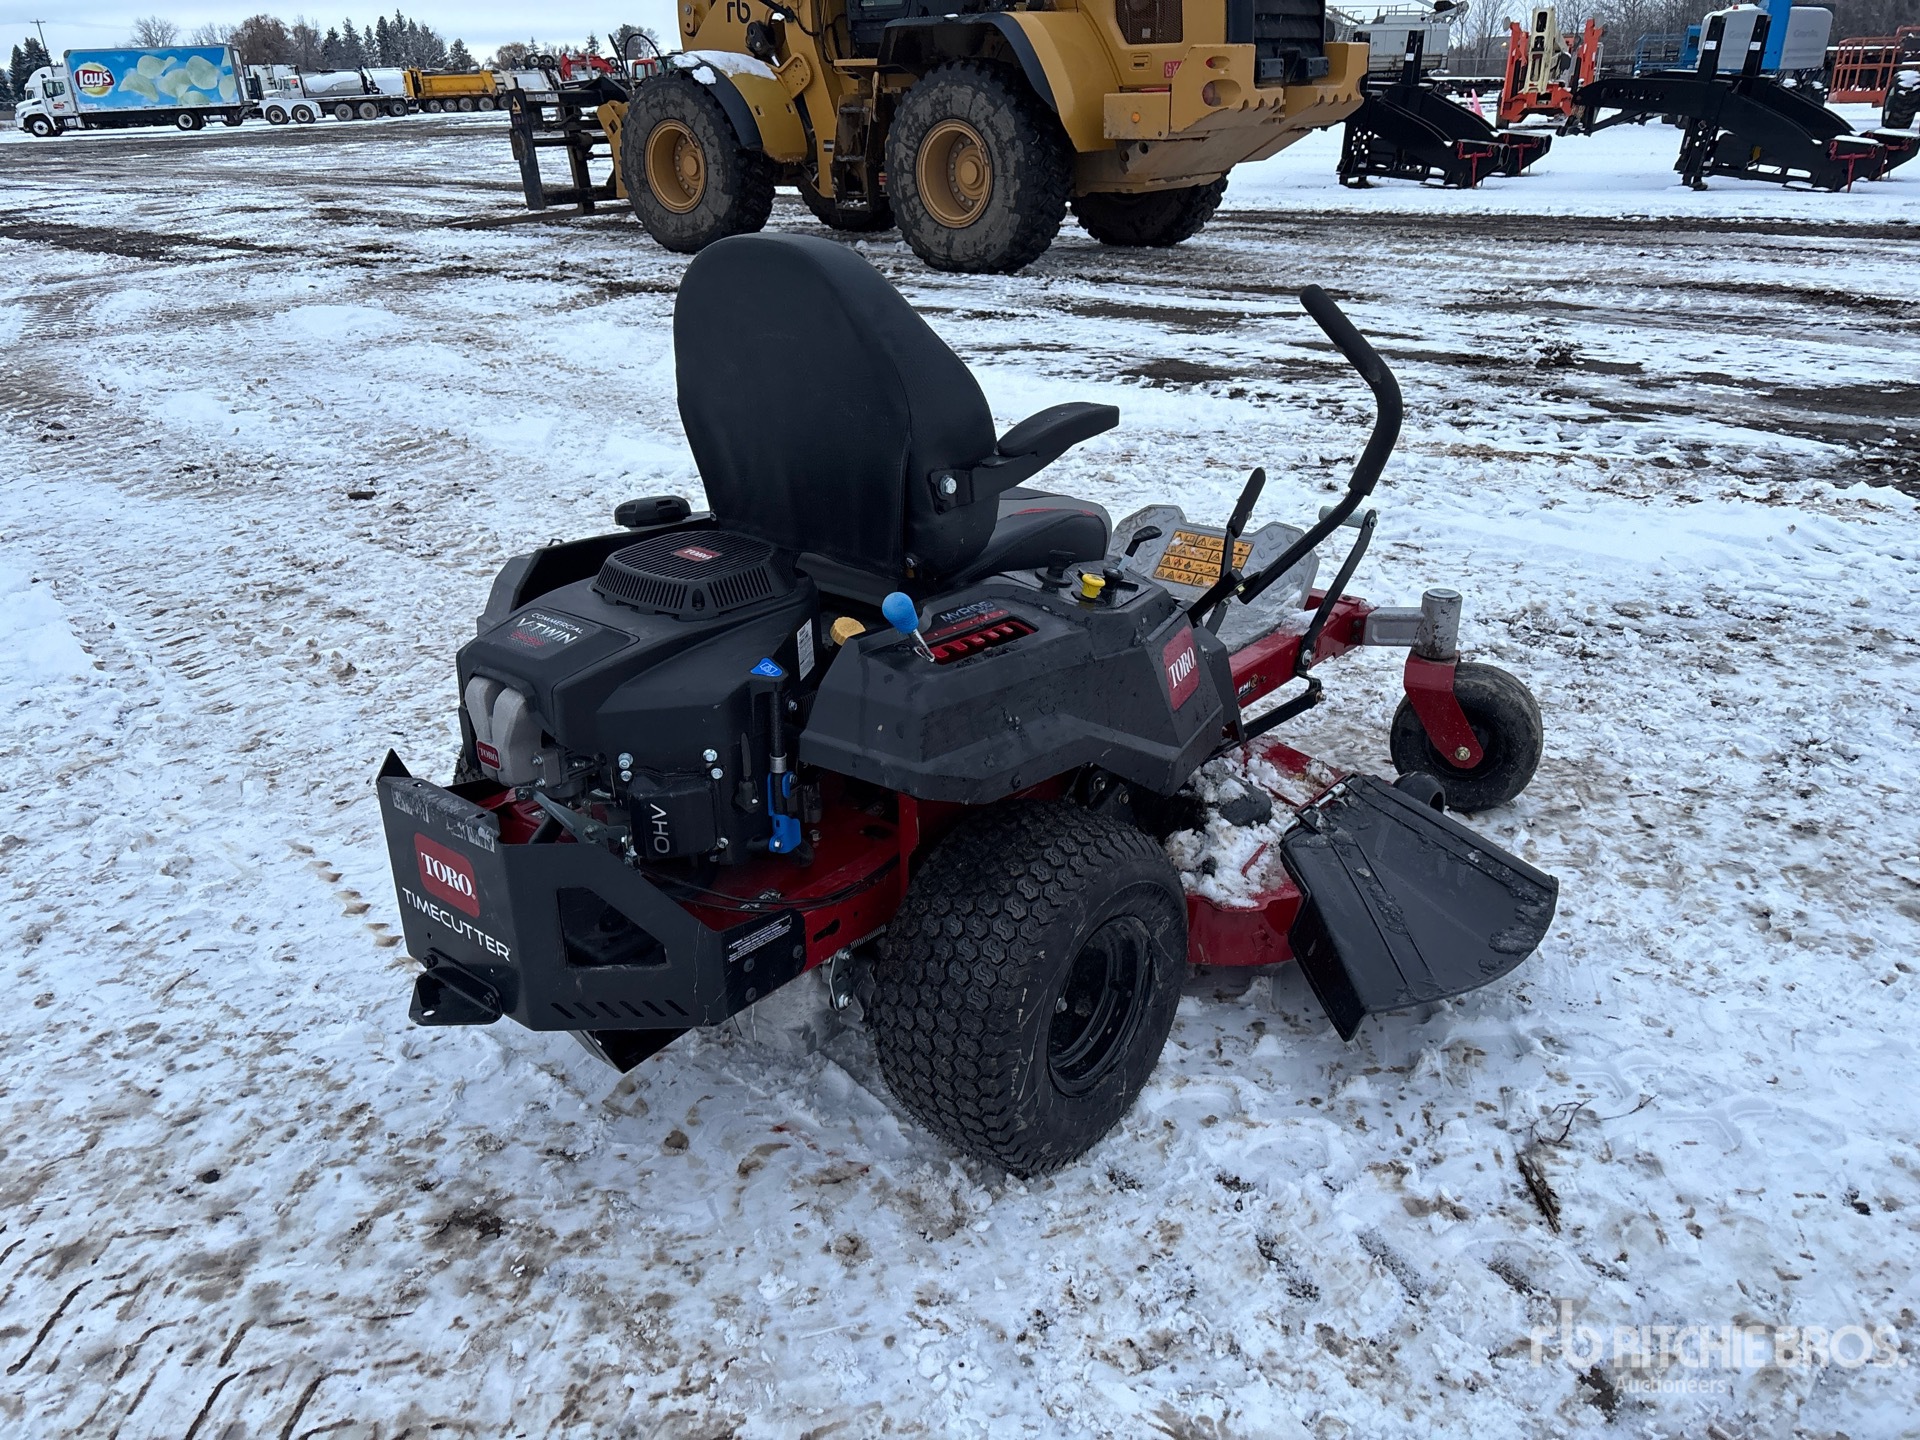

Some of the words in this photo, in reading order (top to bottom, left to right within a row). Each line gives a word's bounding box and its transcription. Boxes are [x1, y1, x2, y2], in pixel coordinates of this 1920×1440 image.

[79, 68, 111, 88] Lay's
[684, 549, 712, 560] TORO
[531, 612, 584, 634] COMMERCIAL
[1168, 646, 1196, 689] TORO
[479, 747, 499, 762] TORO
[650, 803, 670, 854] OHV
[421, 851, 473, 897] TORO
[402, 886, 511, 962] TIMECUTTER
